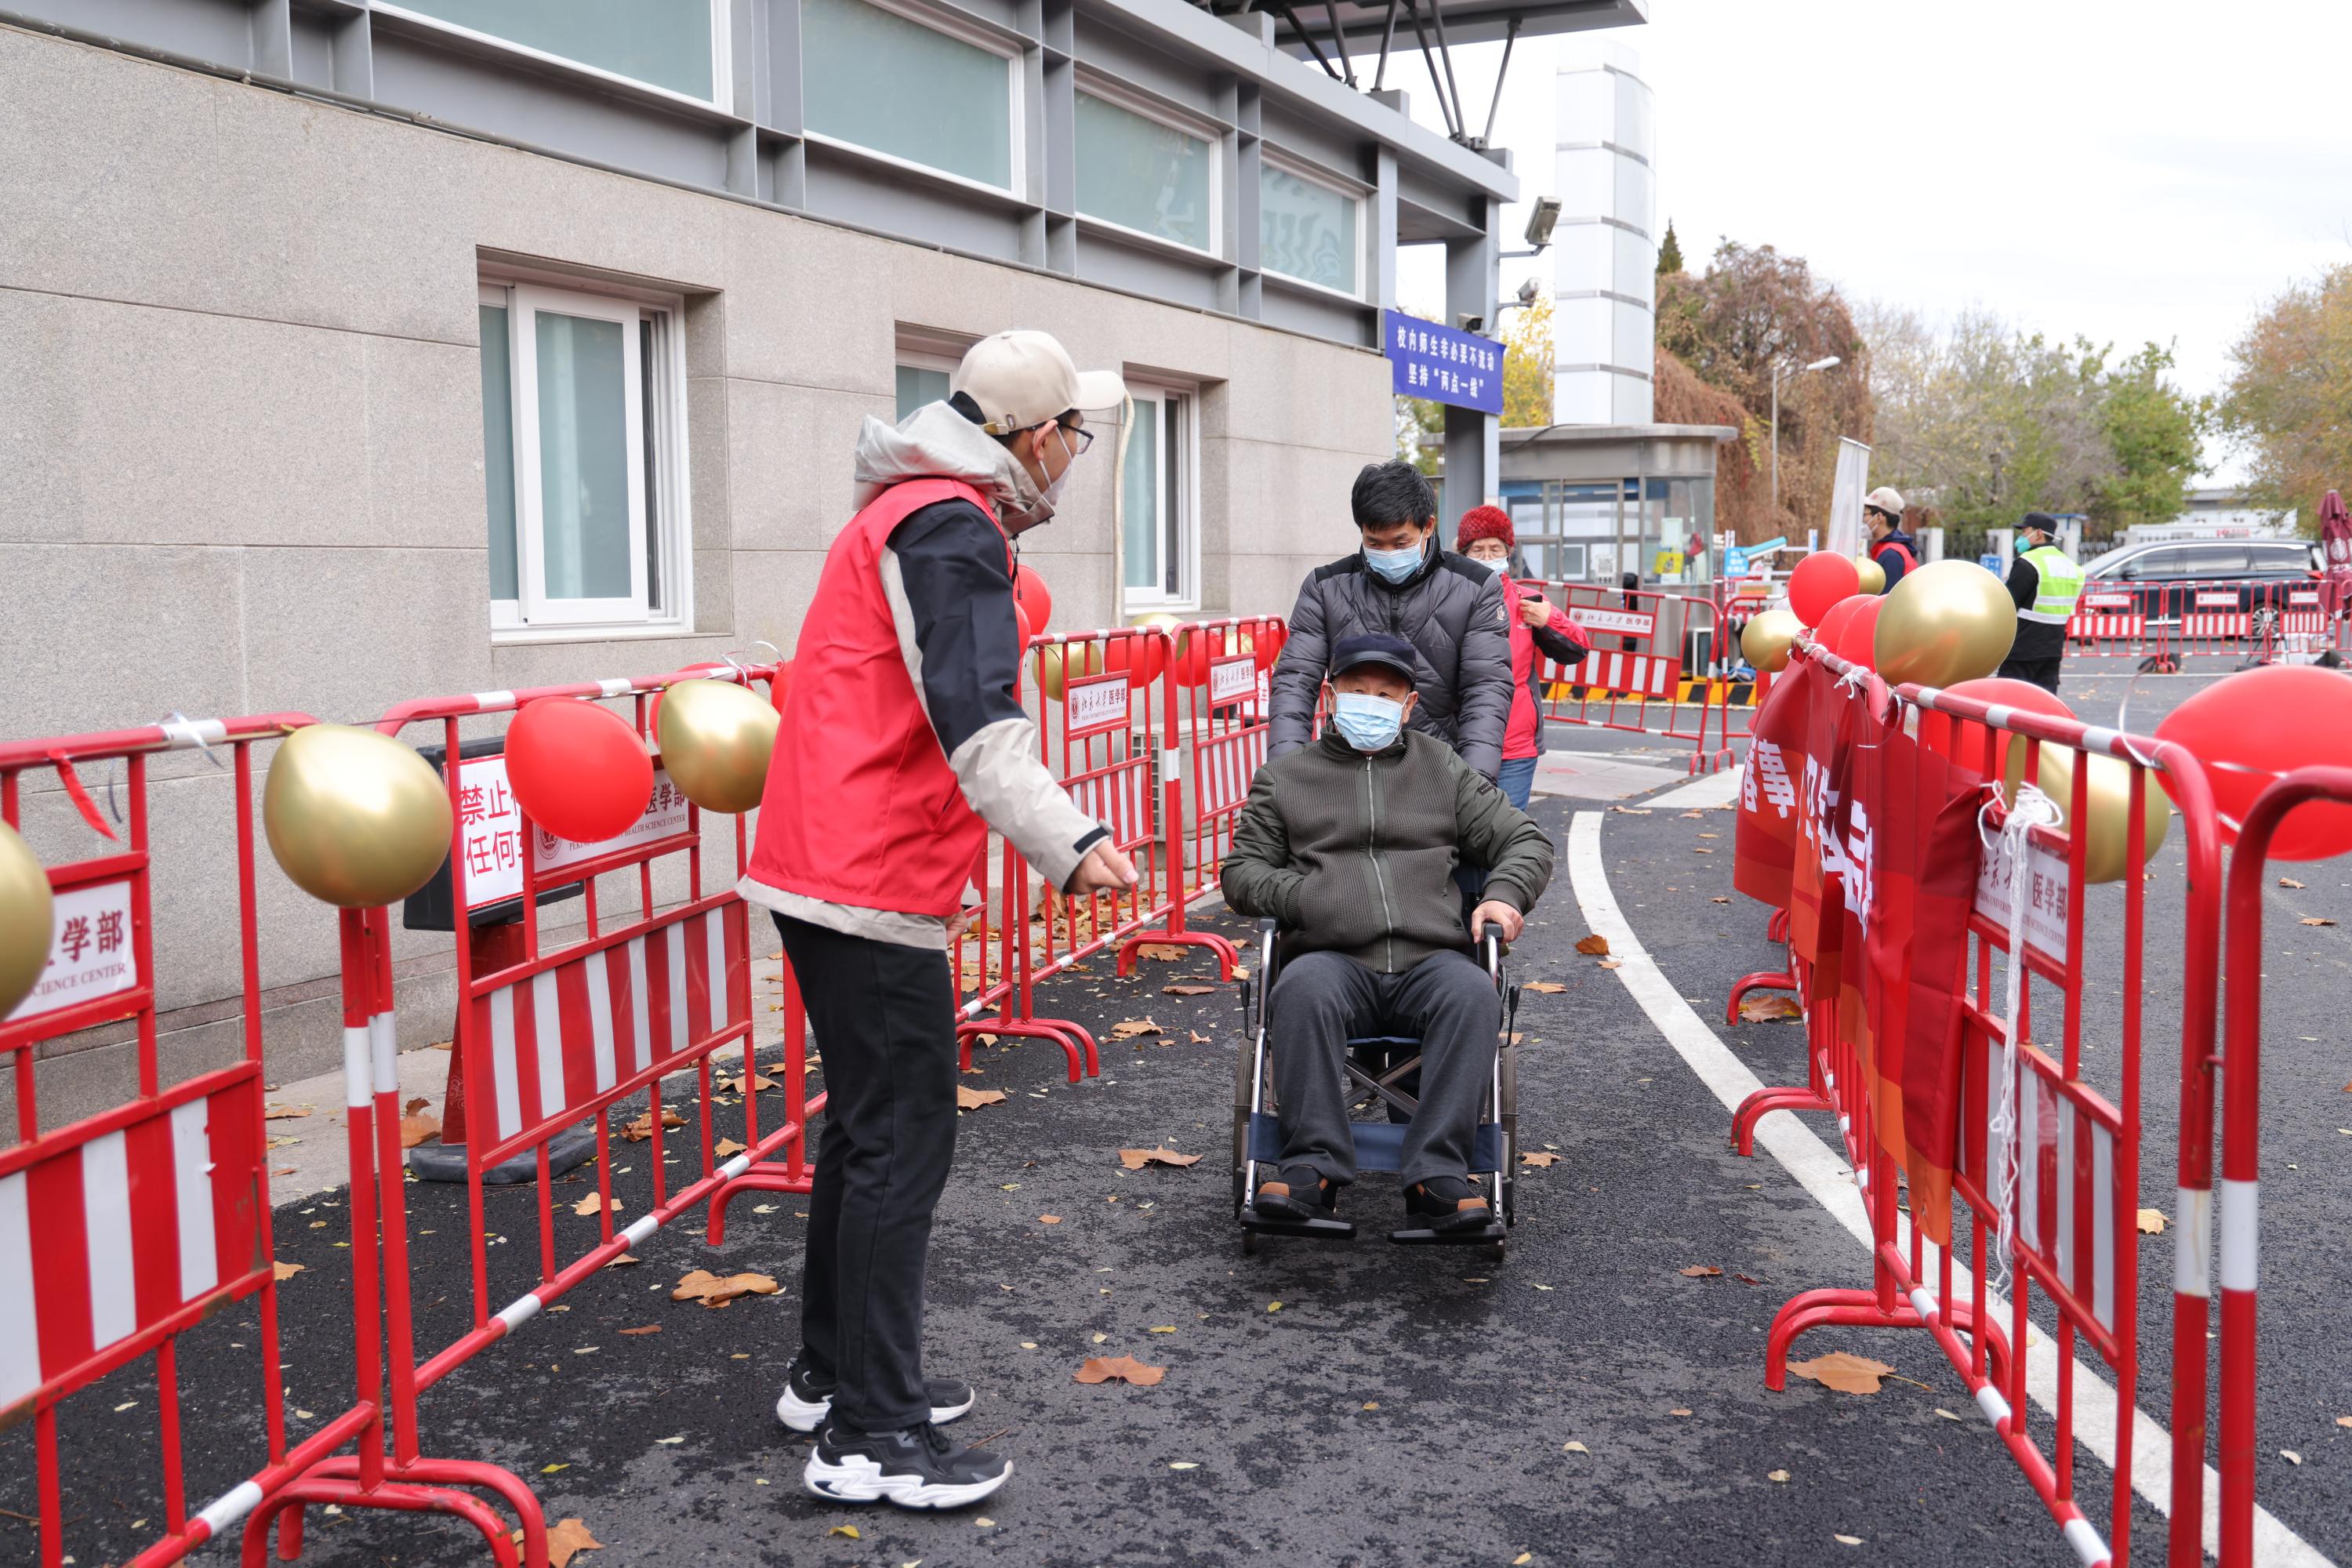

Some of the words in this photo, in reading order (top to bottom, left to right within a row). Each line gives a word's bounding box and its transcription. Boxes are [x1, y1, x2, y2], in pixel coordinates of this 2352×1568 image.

[1397, 325, 1494, 371] 校内师生非必要不流动
[459, 779, 520, 826] 禁止
[644, 818, 666, 831] SCIENCE
[667, 814, 685, 826] CENTER
[47, 909, 124, 966] 学部
[32, 974, 78, 997] CIENCE
[80, 963, 126, 985] CENTER
